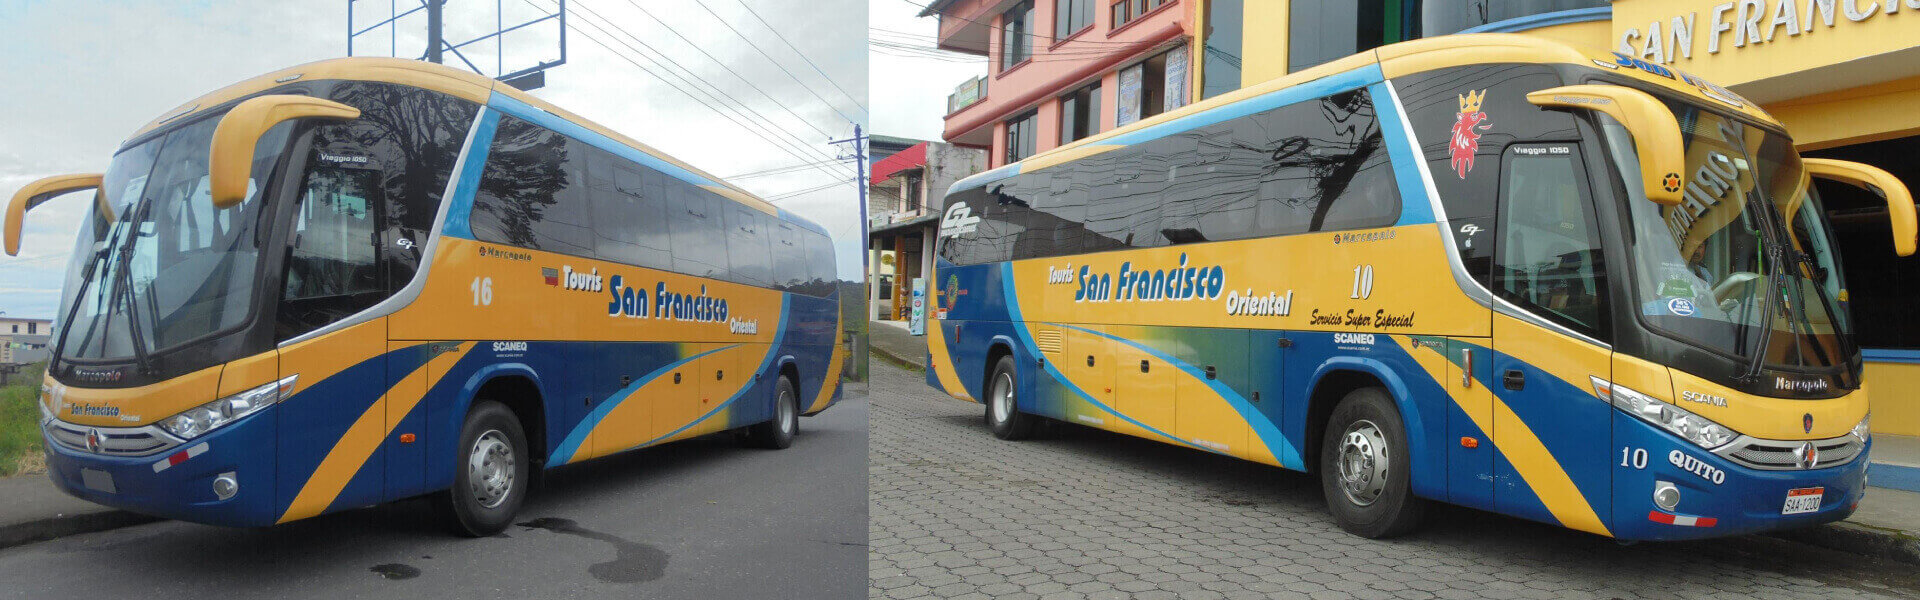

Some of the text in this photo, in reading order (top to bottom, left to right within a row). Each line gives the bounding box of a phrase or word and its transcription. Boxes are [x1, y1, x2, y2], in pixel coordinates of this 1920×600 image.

[1618, 12, 1697, 64] SAN
[1611, 51, 1676, 80] San
[320, 153, 351, 162] Viaggio
[1513, 146, 1570, 155] Viaggio 1050
[1342, 230, 1396, 243] Marcopolo
[487, 246, 532, 262] Marcopolo
[471, 276, 493, 306] 16
[1048, 252, 1293, 317] Touris San Francisco Oriental
[1350, 264, 1374, 300] 10
[562, 264, 758, 336] Touris San Francisco Oriental
[1310, 309, 1414, 329] Servicio Super Especial
[493, 341, 528, 352] SCANEQ
[1334, 333, 1375, 345] SCANEQ
[75, 369, 121, 382] Marcopolo
[1775, 376, 1828, 392] Marcopolo
[1682, 390, 1728, 408] SCANIA
[71, 402, 83, 416] San
[85, 402, 119, 418] Francisco
[1620, 447, 1648, 470] 10
[1668, 450, 1725, 485] QUITO
